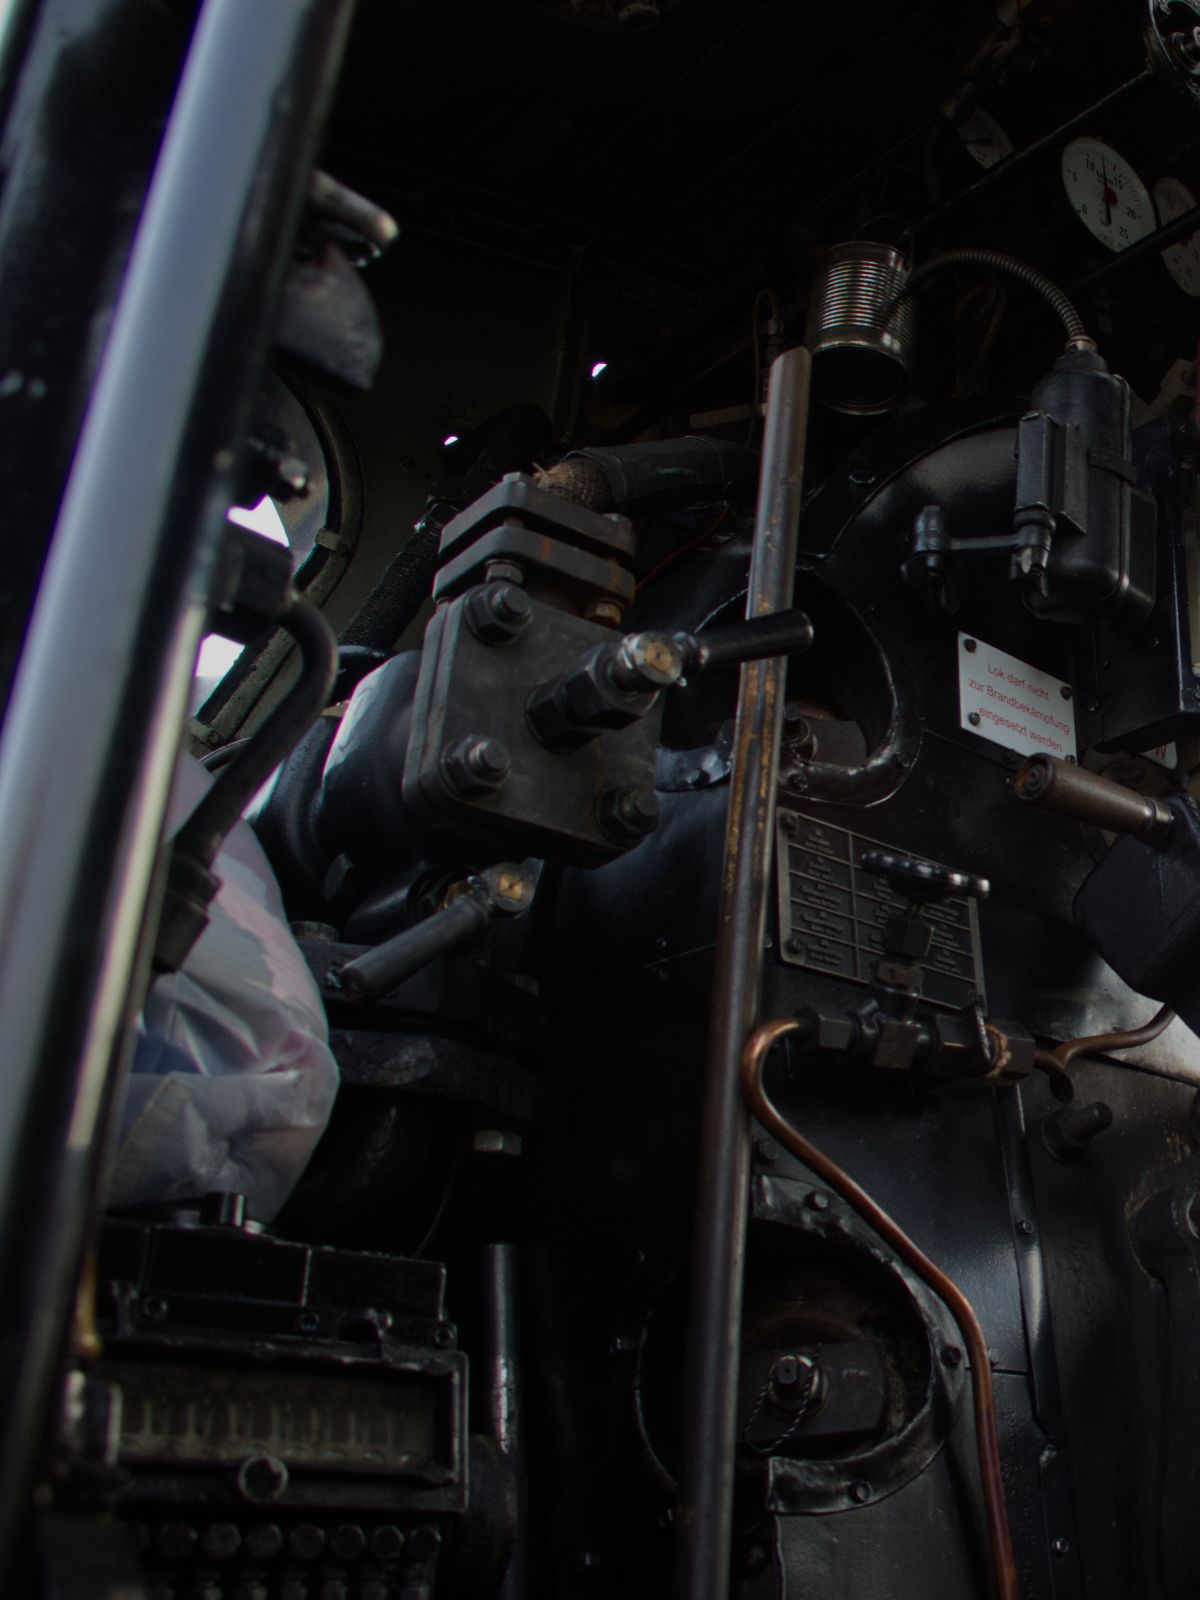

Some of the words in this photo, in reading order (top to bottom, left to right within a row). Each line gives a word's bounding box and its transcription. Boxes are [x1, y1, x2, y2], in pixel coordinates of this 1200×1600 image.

[1126, 206, 1136, 220] 20
[1119, 226, 1129, 240] 25
[987, 663, 1005, 679] Lok
[1007, 673, 1026, 689] darf
[1027, 682, 1049, 701] nicht
[968, 678, 985, 692] zur
[987, 685, 1071, 736] Brandbekämpfung
[979, 707, 1028, 737] eingesetzt
[1029, 730, 1063, 752] werden
